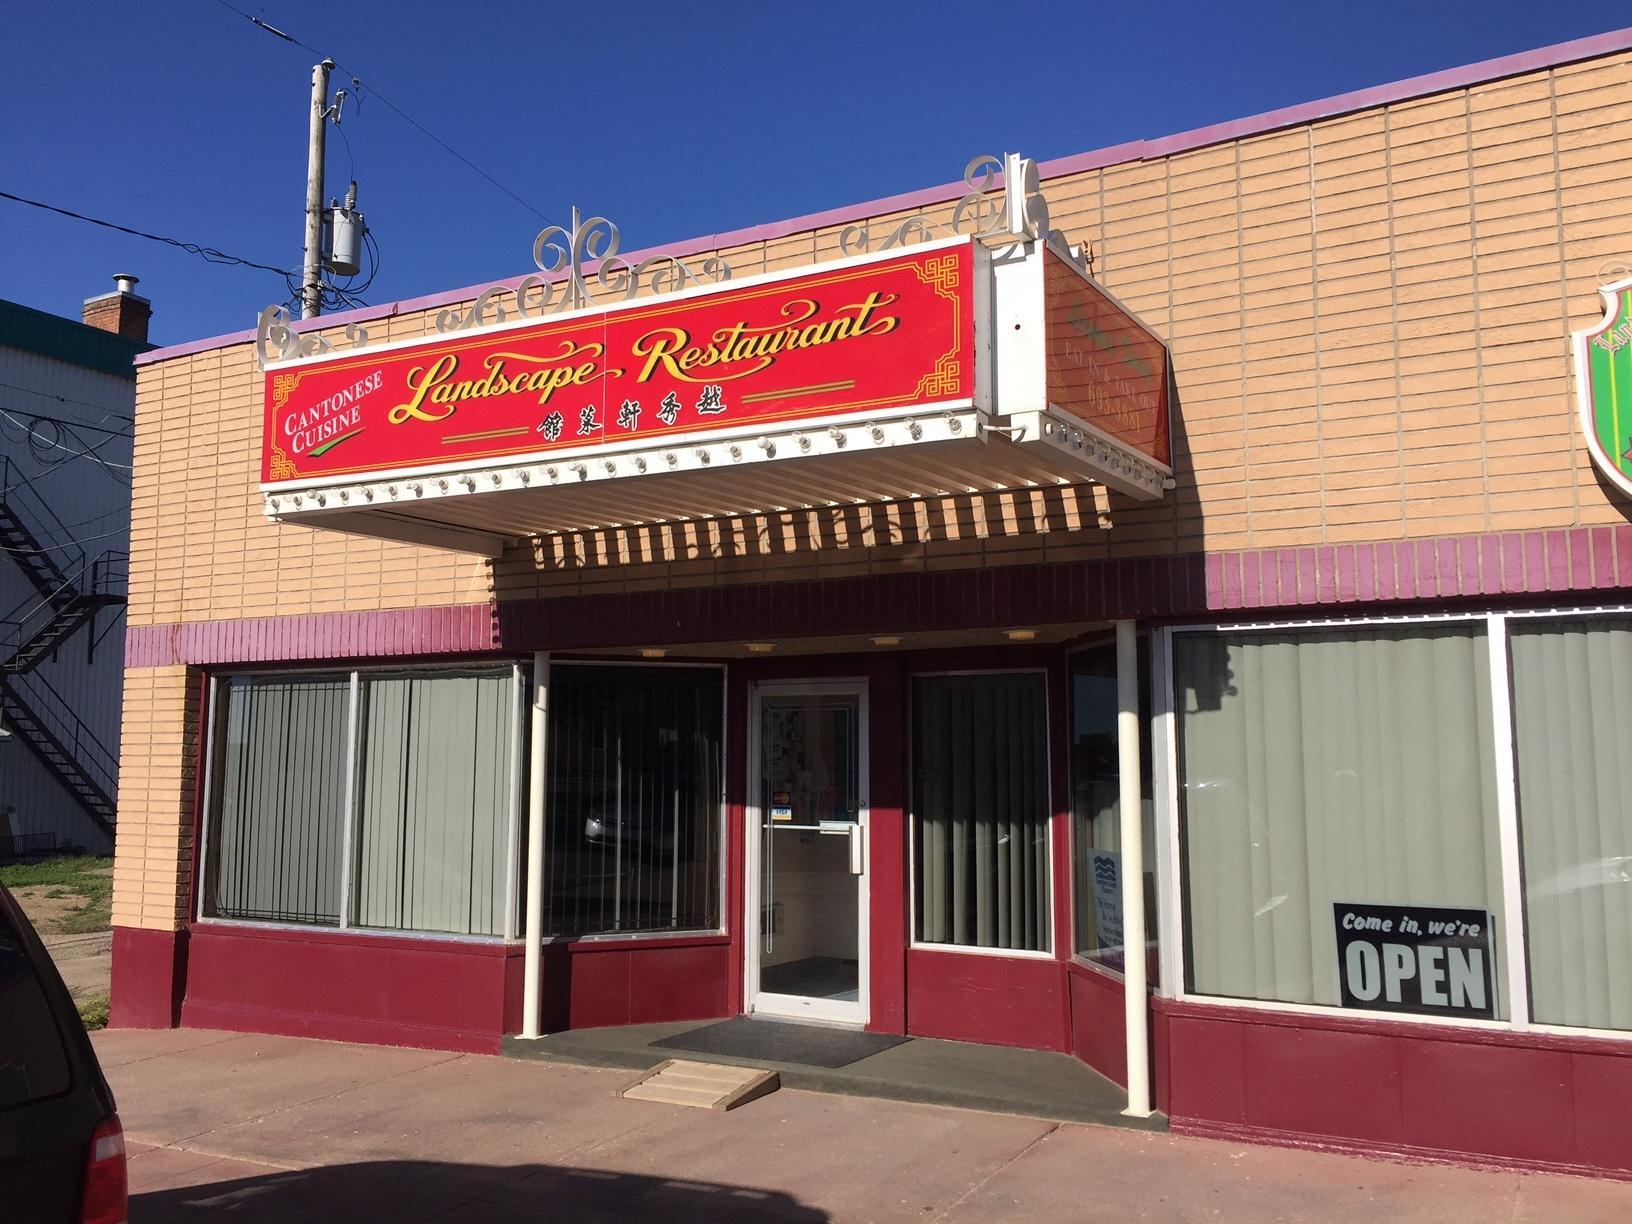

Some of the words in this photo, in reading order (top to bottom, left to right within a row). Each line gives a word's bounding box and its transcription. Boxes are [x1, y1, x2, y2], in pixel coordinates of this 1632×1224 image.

[388, 341, 618, 424] Landscape
[632, 291, 900, 383] Restaurant
[284, 370, 383, 436] CANTONESE
[292, 407, 361, 454] CUISINE
[1342, 912, 1393, 932] Come
[1398, 915, 1423, 936] in,
[1428, 919, 1481, 937] we're
[1345, 940, 1487, 1009] OPEN
